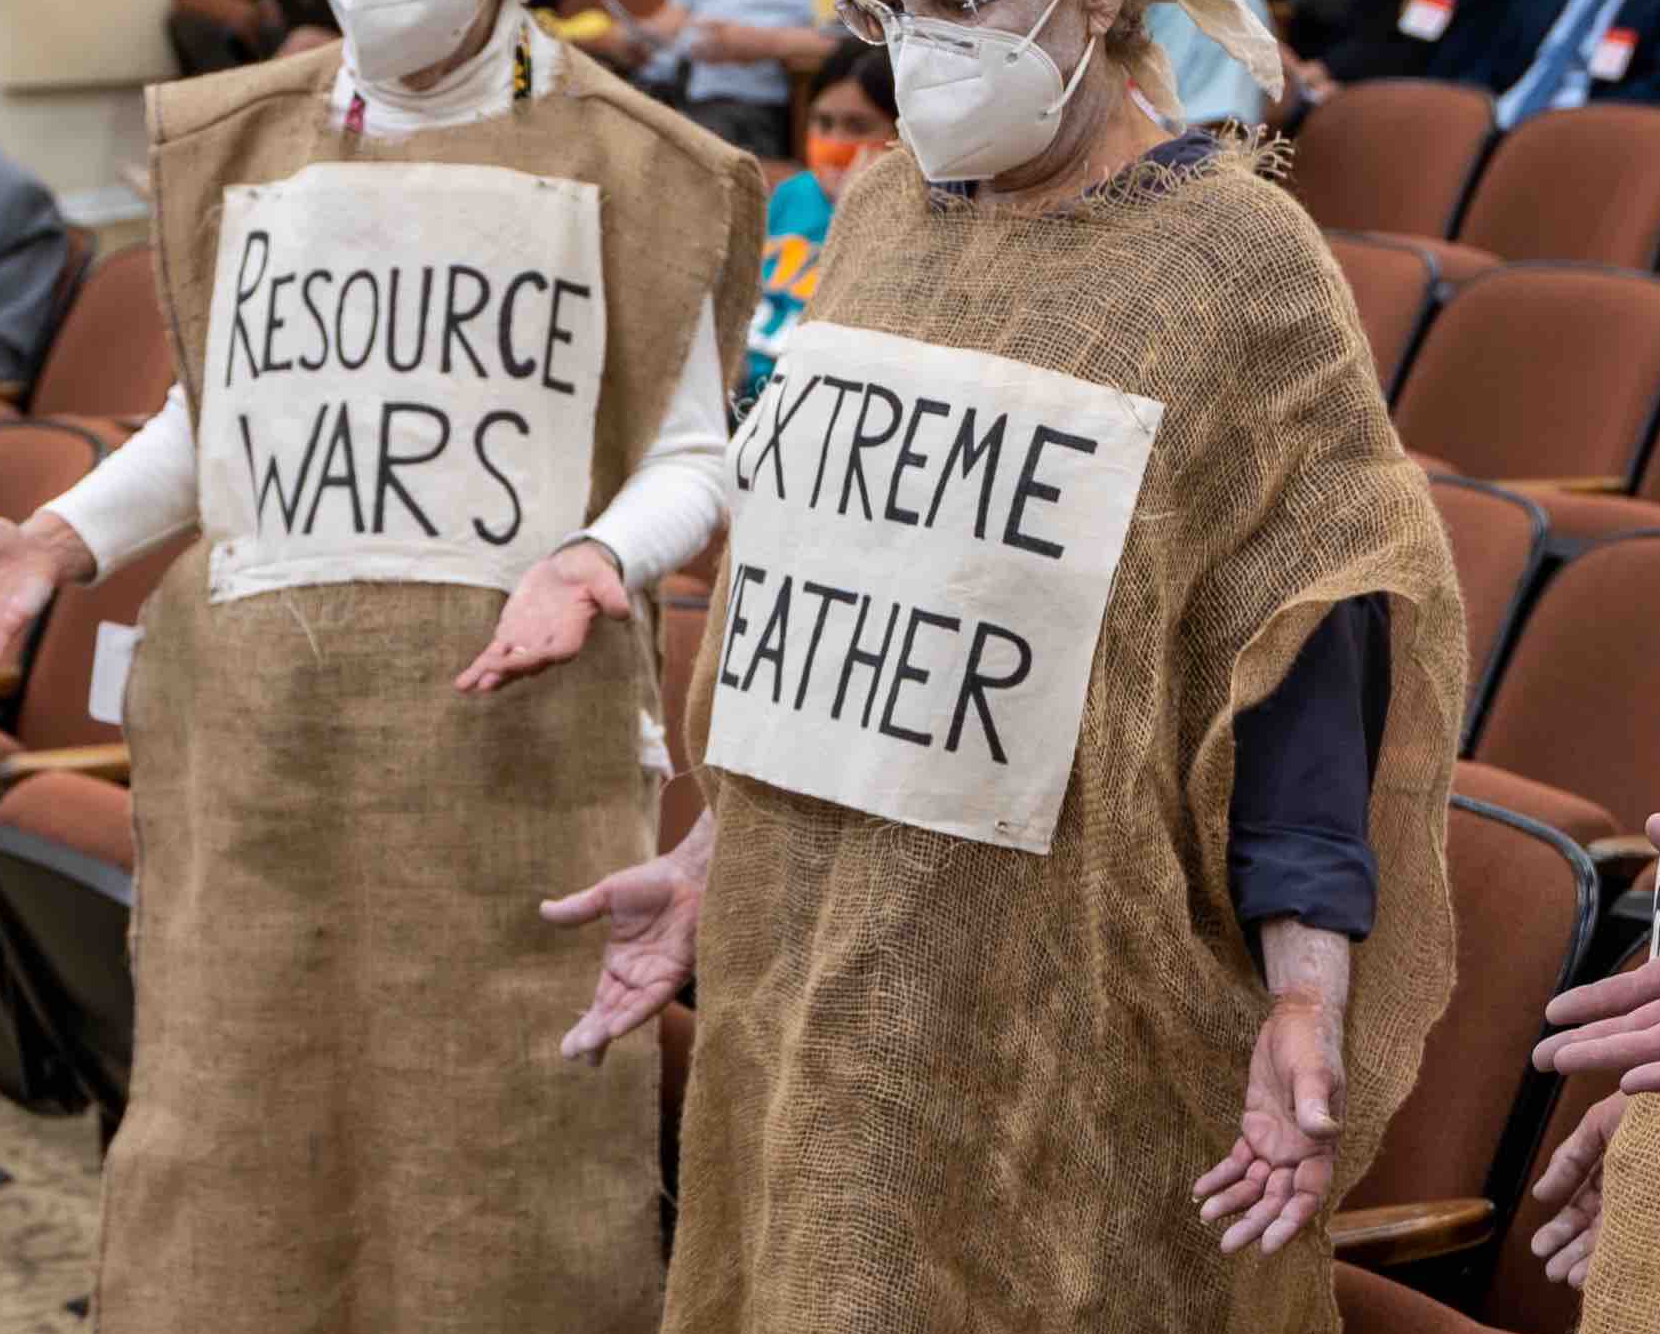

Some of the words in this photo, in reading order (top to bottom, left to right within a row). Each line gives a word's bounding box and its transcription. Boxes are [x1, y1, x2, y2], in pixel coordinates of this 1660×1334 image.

[225, 231, 591, 395] RESOURCE
[239, 402, 530, 546] WARS
[720, 563, 1032, 765] EATHER
